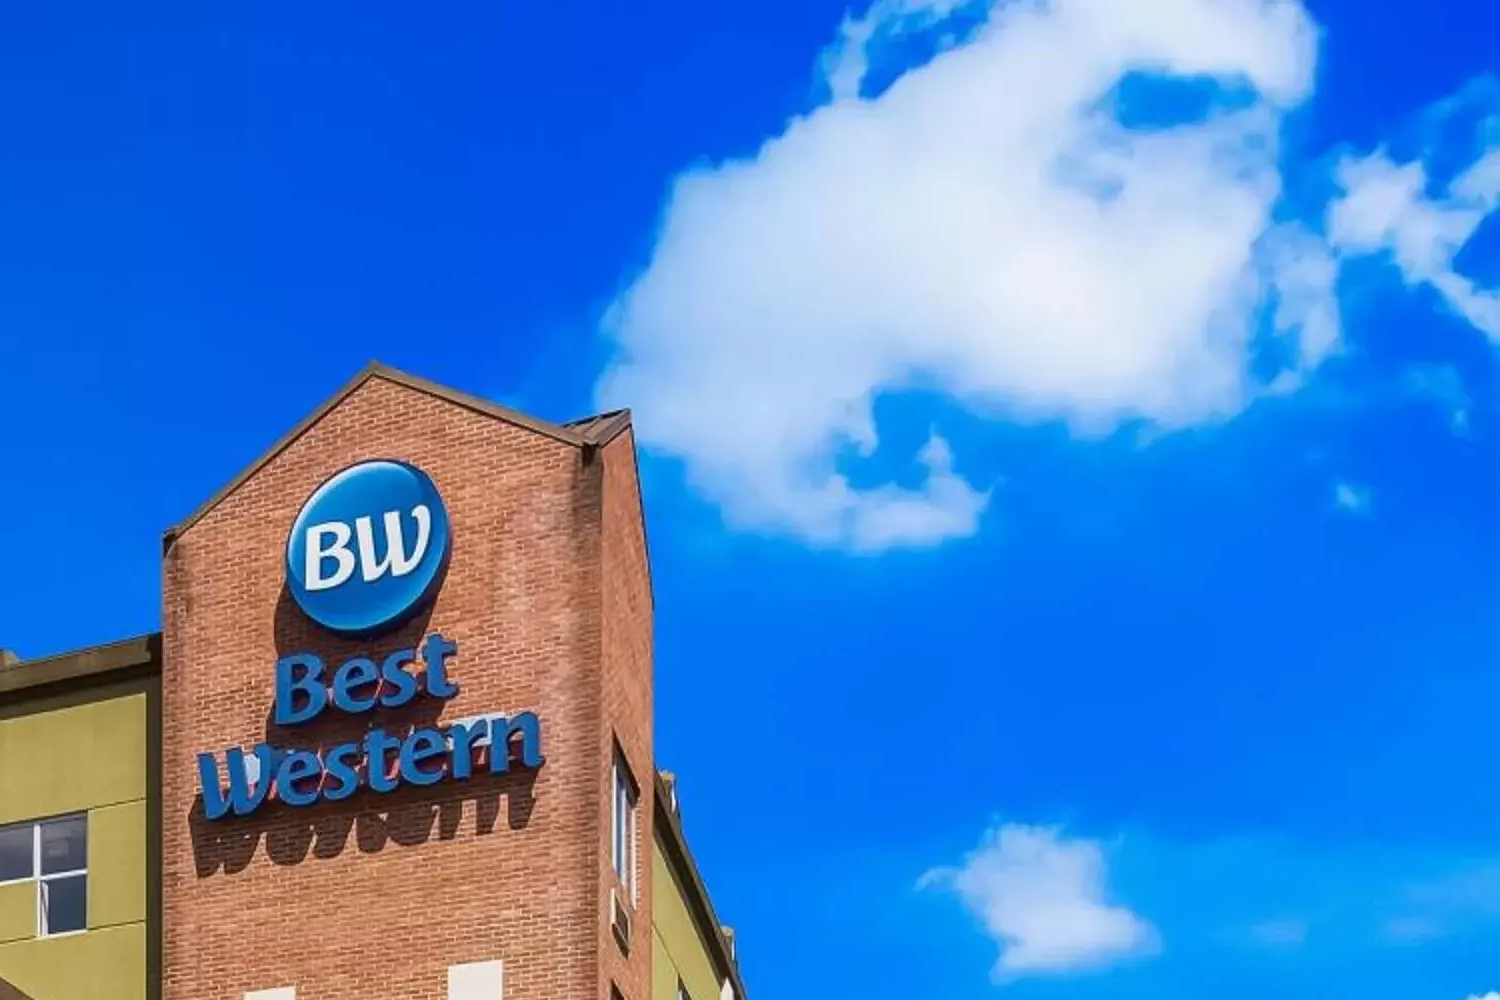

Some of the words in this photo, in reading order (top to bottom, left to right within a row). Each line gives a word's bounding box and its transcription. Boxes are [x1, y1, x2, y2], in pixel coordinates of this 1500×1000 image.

[305, 504, 431, 591] BW
[274, 632, 459, 727] Best
[198, 710, 545, 821] Western
